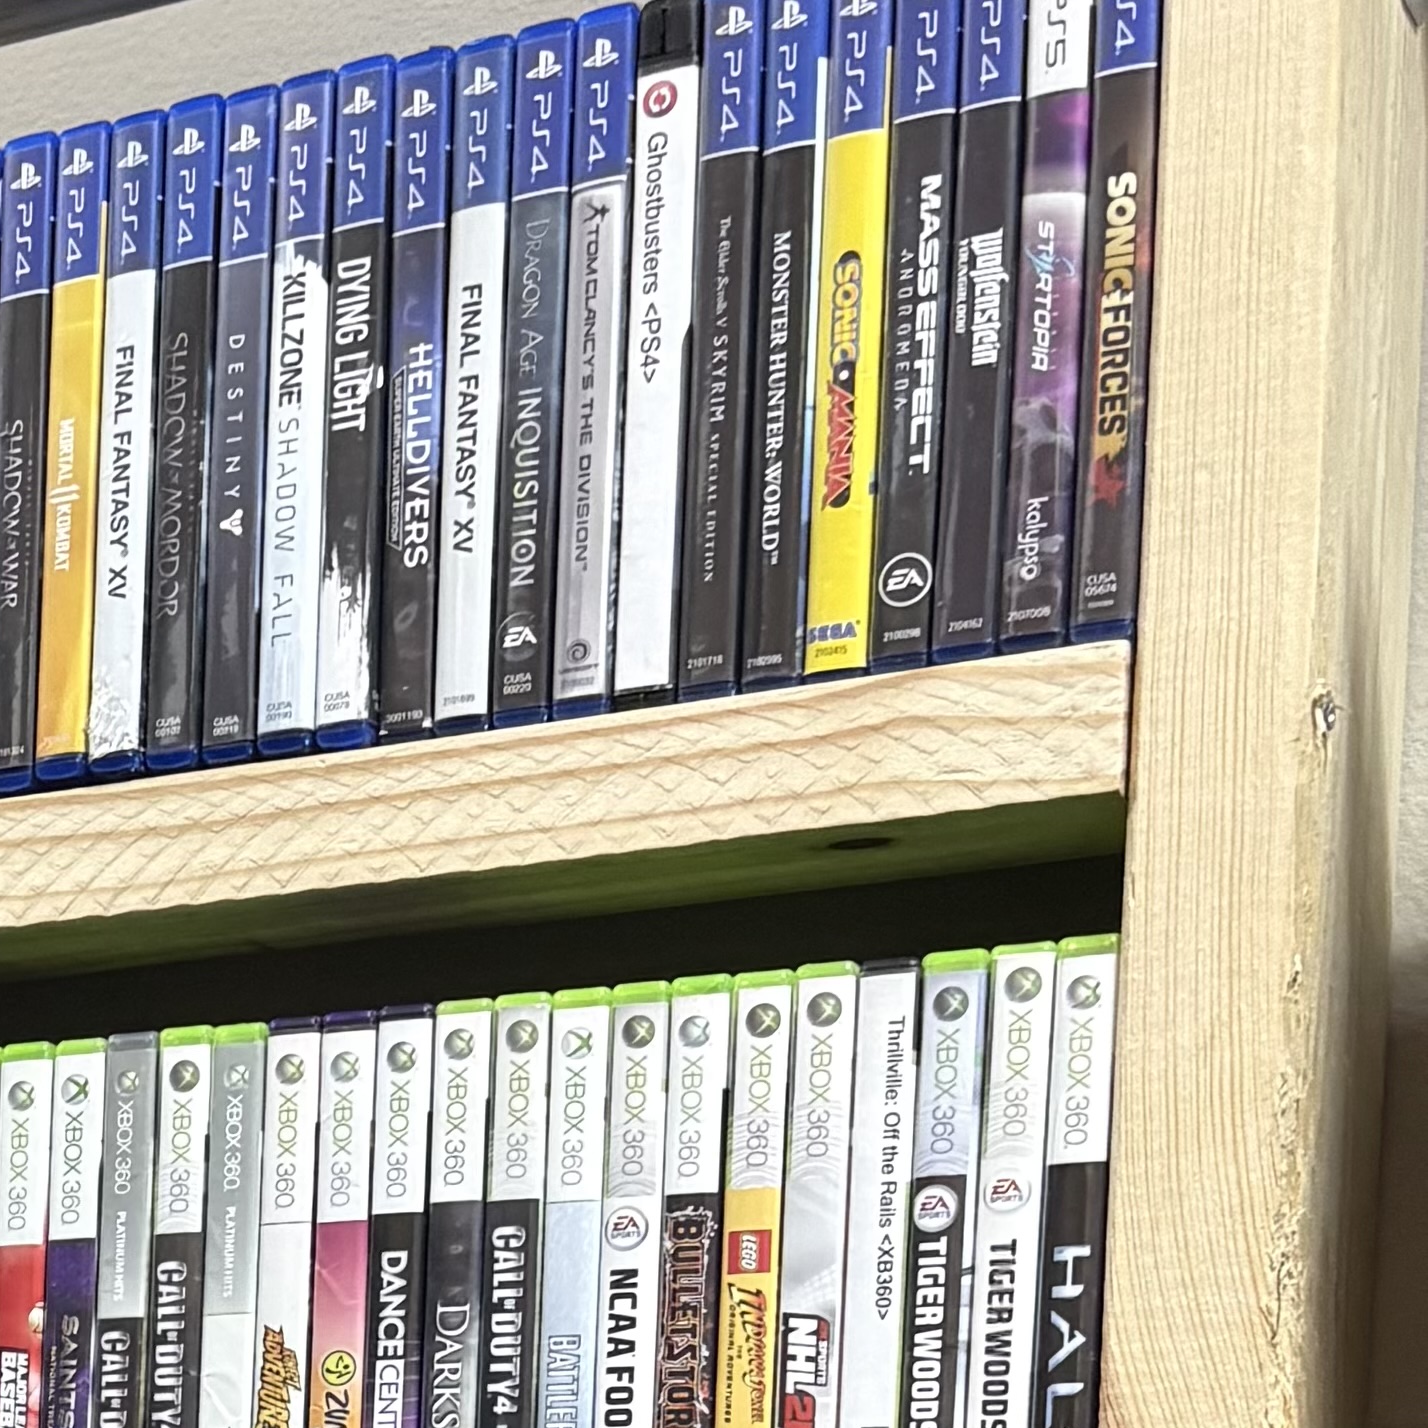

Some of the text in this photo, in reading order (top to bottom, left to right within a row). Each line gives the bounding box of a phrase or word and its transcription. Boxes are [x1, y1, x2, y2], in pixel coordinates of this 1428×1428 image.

[642, 131, 668, 295] Ghostbusters
[336, 256, 371, 345] DYING
[905, 174, 942, 475] MASS EFFECT
[1095, 171, 1138, 437] SONIC FORCES
[114, 345, 135, 425] FINAL
[225, 334, 245, 498] DESTINY
[274, 418, 299, 552] SHADOW
[402, 343, 433, 568] HELLDIVERS
[509, 387, 542, 588] INQUISITION
[107, 562, 126, 600] XV
[270, 573, 294, 647] FALL
[443, 1067, 468, 1186] XBOX 360
[882, 1149, 899, 1175] the
[883, 1111, 901, 1145] Off
[880, 1180, 898, 1229] Rails
[380, 1250, 408, 1356] DANCE
